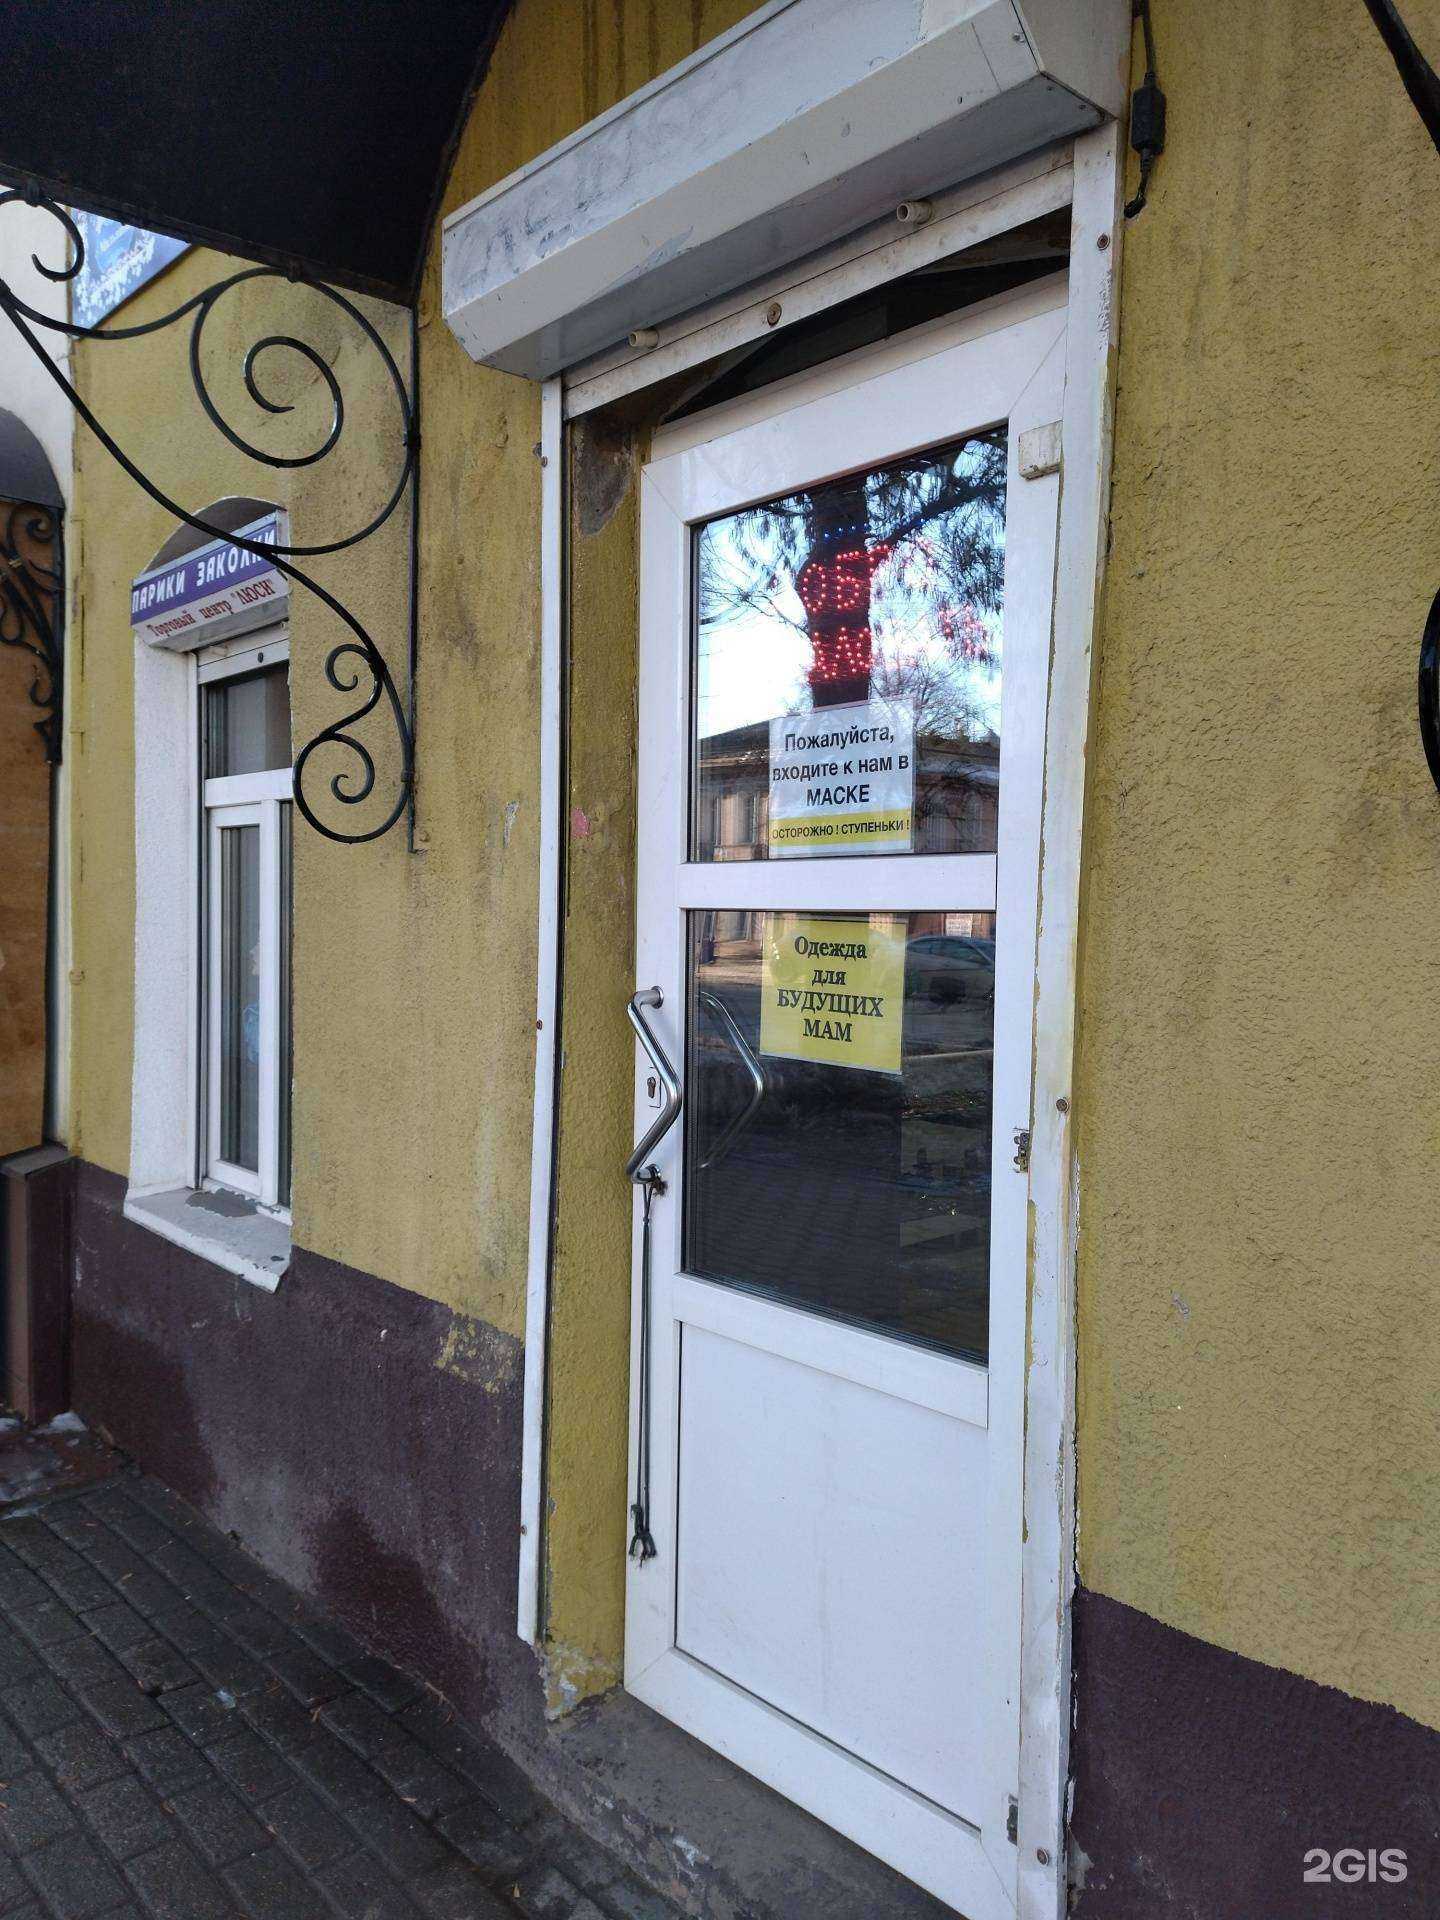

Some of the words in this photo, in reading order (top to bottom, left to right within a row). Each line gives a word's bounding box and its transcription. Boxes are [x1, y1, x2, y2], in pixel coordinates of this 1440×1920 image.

[132, 572, 186, 613] ПАРИКИ
[147, 611, 196, 637] Торговый
[199, 599, 234, 619] центр
[230, 578, 276, 605] "ЛЮСИ"
[785, 726, 894, 751] Пожалуйста,
[772, 761, 838, 782] входите
[843, 760, 853, 775] к
[858, 756, 892, 773] нам
[806, 784, 870, 806] МАСКЕ
[794, 936, 867, 961] Одежда
[811, 969, 847, 987] для
[776, 988, 884, 1018] БУДУЩИХ
[802, 1018, 853, 1042] МАМ
